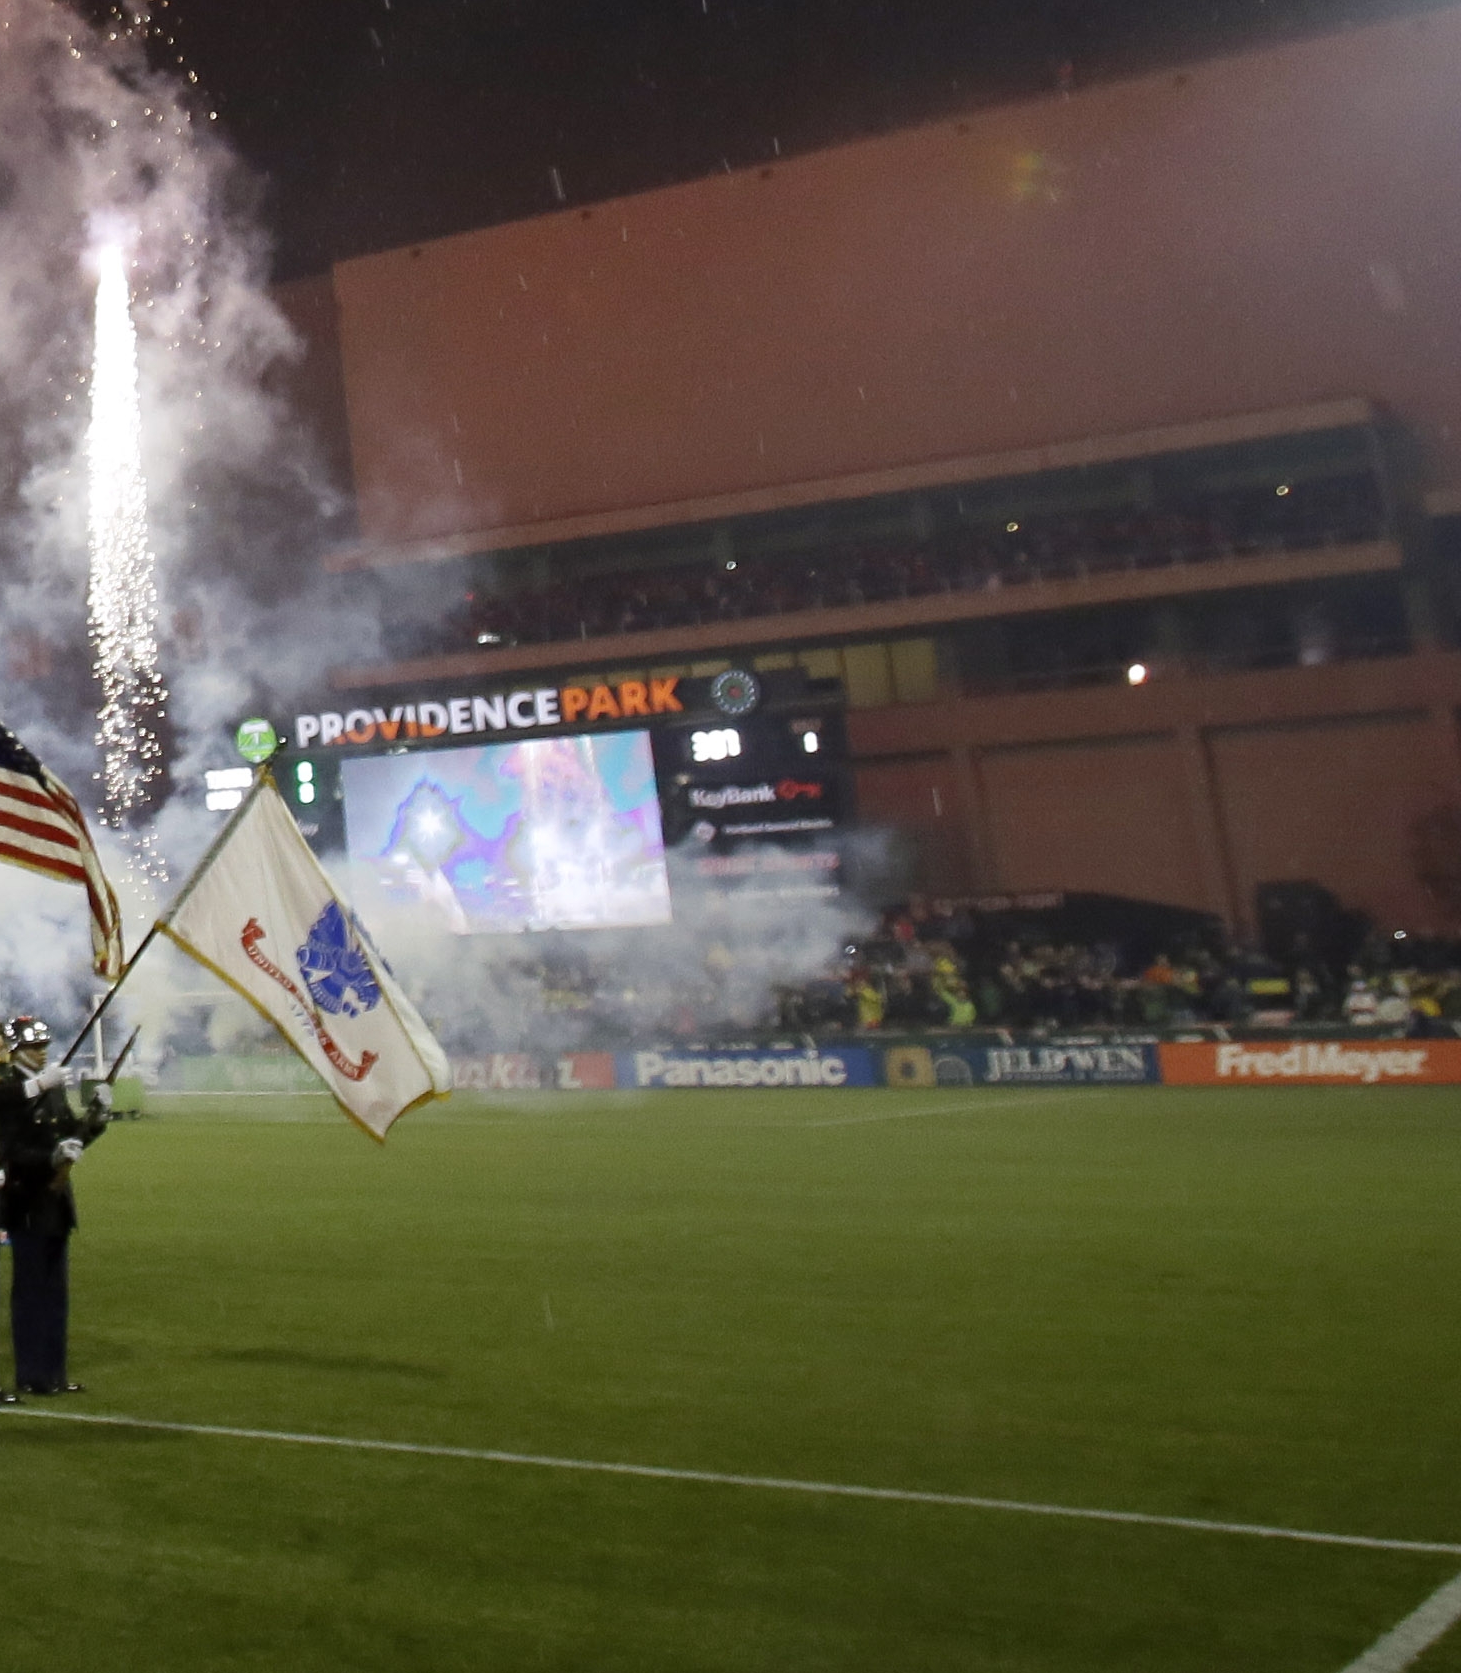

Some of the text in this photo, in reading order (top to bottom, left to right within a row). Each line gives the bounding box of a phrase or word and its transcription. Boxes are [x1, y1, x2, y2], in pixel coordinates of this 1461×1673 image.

[295, 688, 562, 748] PROVIDENCE
[559, 677, 683, 723] PARK
[690, 783, 776, 809] KeyBank
[635, 1050, 848, 1086] Panasonic
